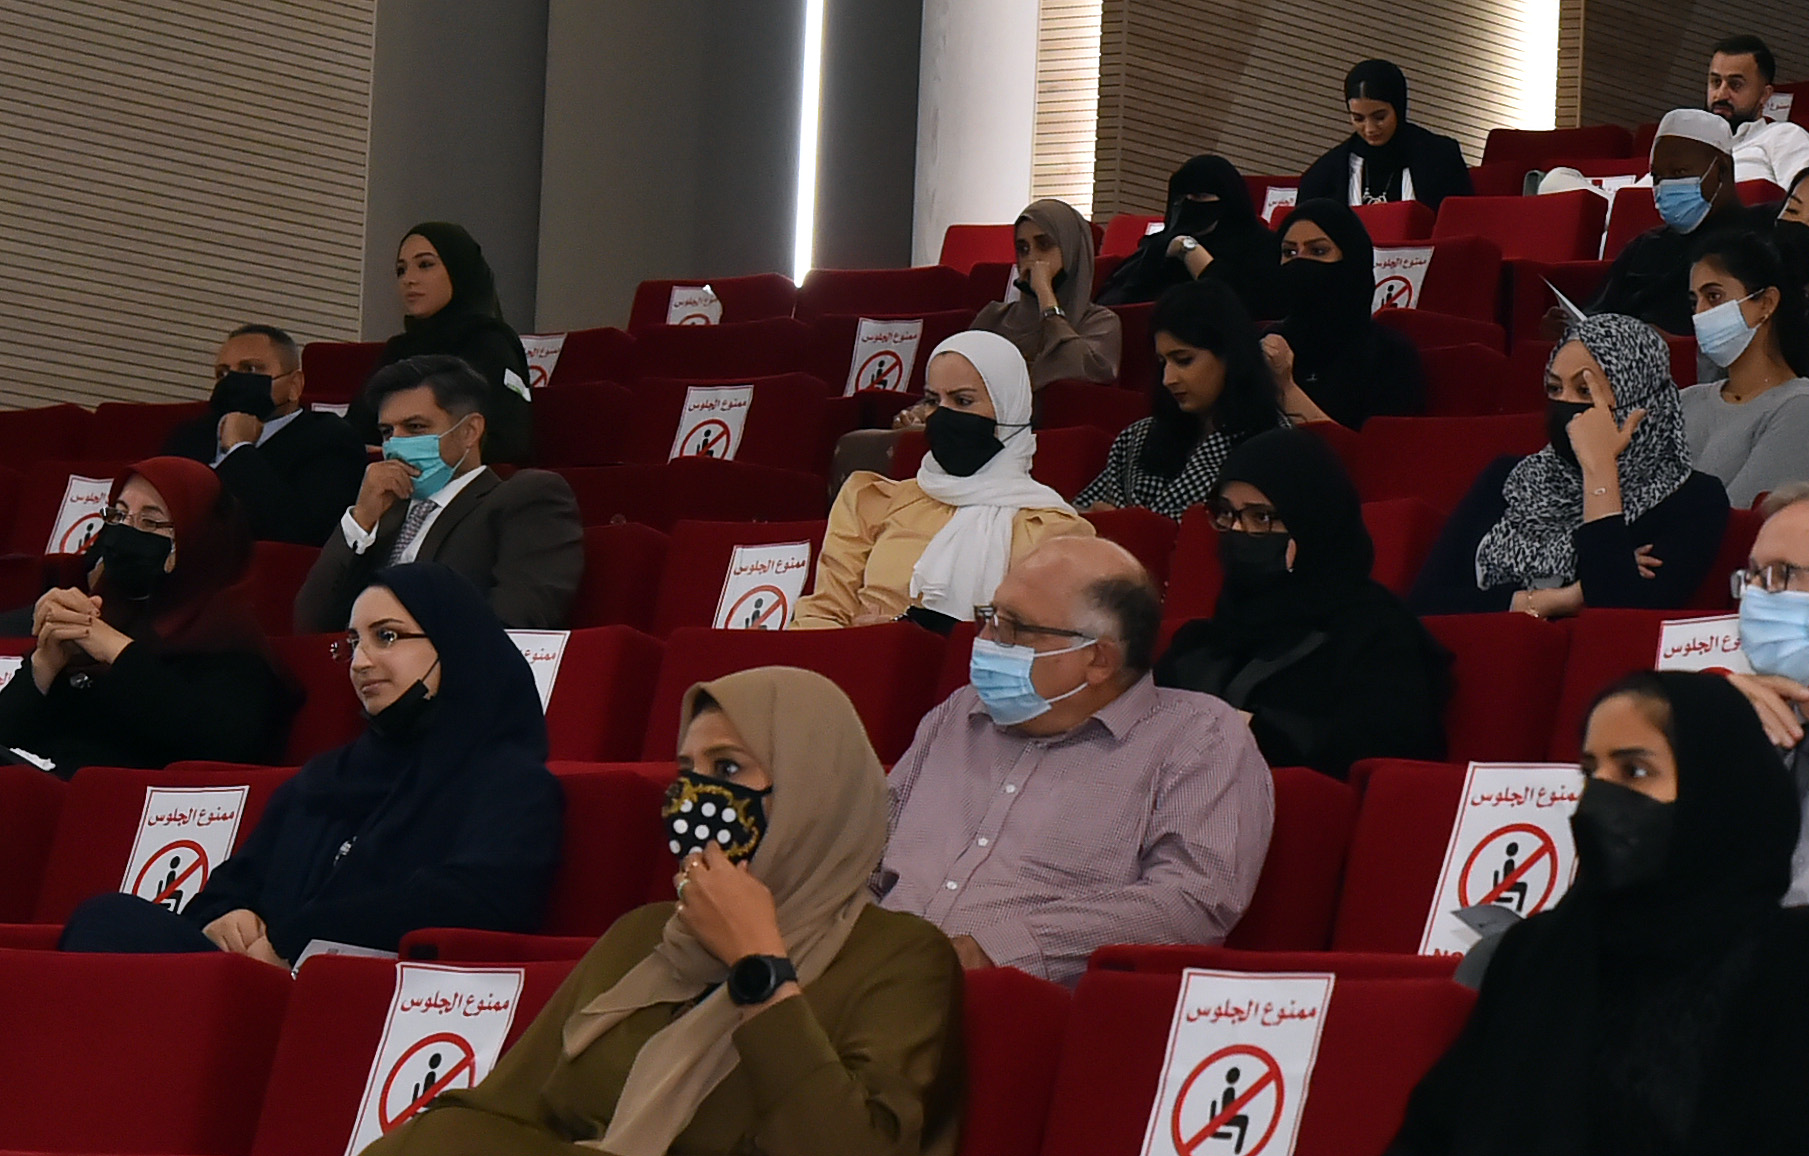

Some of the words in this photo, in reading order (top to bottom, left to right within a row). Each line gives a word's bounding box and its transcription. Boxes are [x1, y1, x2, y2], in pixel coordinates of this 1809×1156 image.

[733, 559, 774, 576] الجلوس
[774, 556, 806, 575] ممنوع
[1662, 635, 1719, 660] الجلوس
[1470, 785, 1534, 808] الجلوس
[147, 807, 197, 827] الجلوس
[197, 806, 236, 827] ممنوع
[400, 990, 463, 1017] الجلوس
[462, 992, 510, 1018] ممنوع
[1186, 998, 1260, 1026] الجلوس
[1261, 999, 1318, 1027] ممنوع
